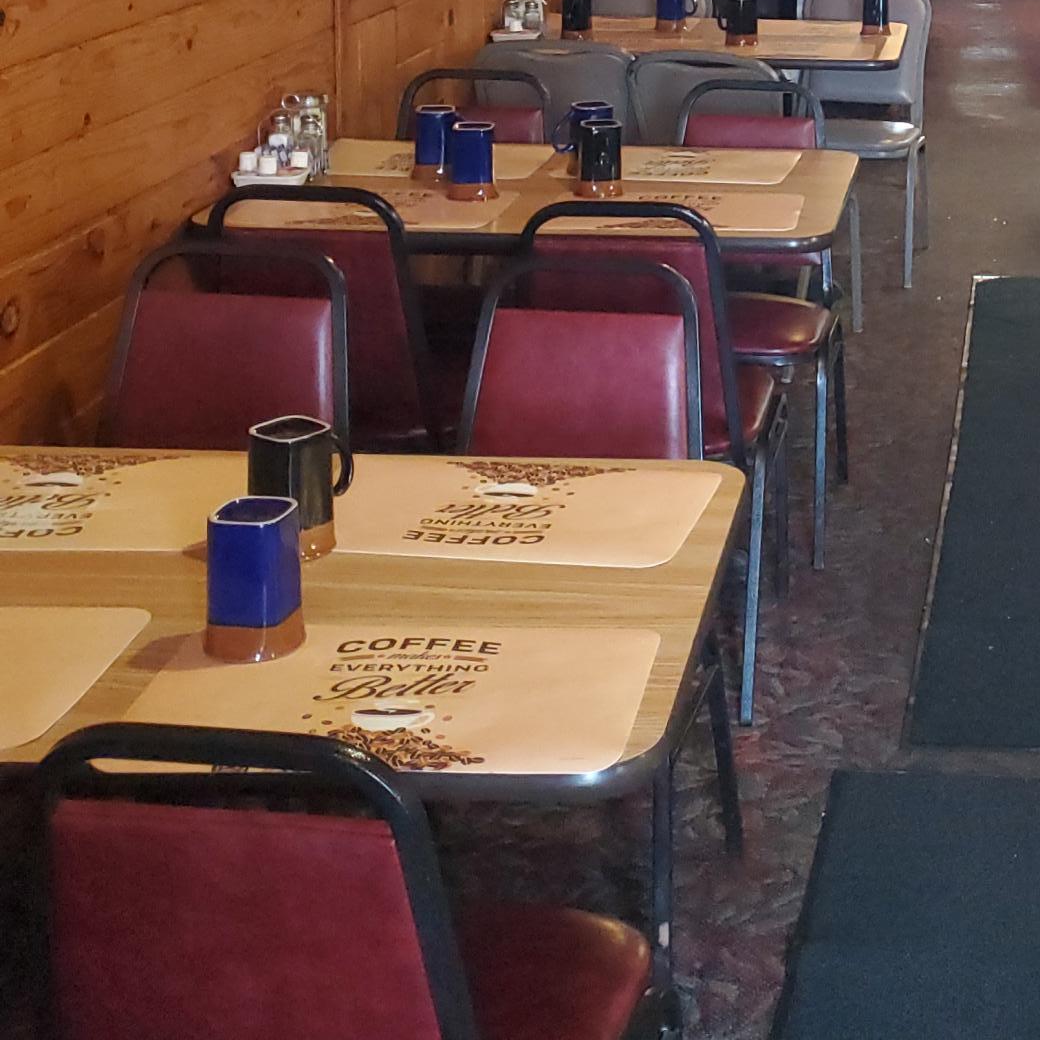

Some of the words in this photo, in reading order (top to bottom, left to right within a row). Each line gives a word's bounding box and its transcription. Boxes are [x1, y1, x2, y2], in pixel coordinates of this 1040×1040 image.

[435, 503, 567, 521] Better
[418, 517, 553, 531] EVERYTHING
[401, 529, 546, 546] COFFEE
[336, 637, 502, 655] COFFEE
[329, 662, 491, 673] EVERYTHING
[312, 672, 476, 701] Better
